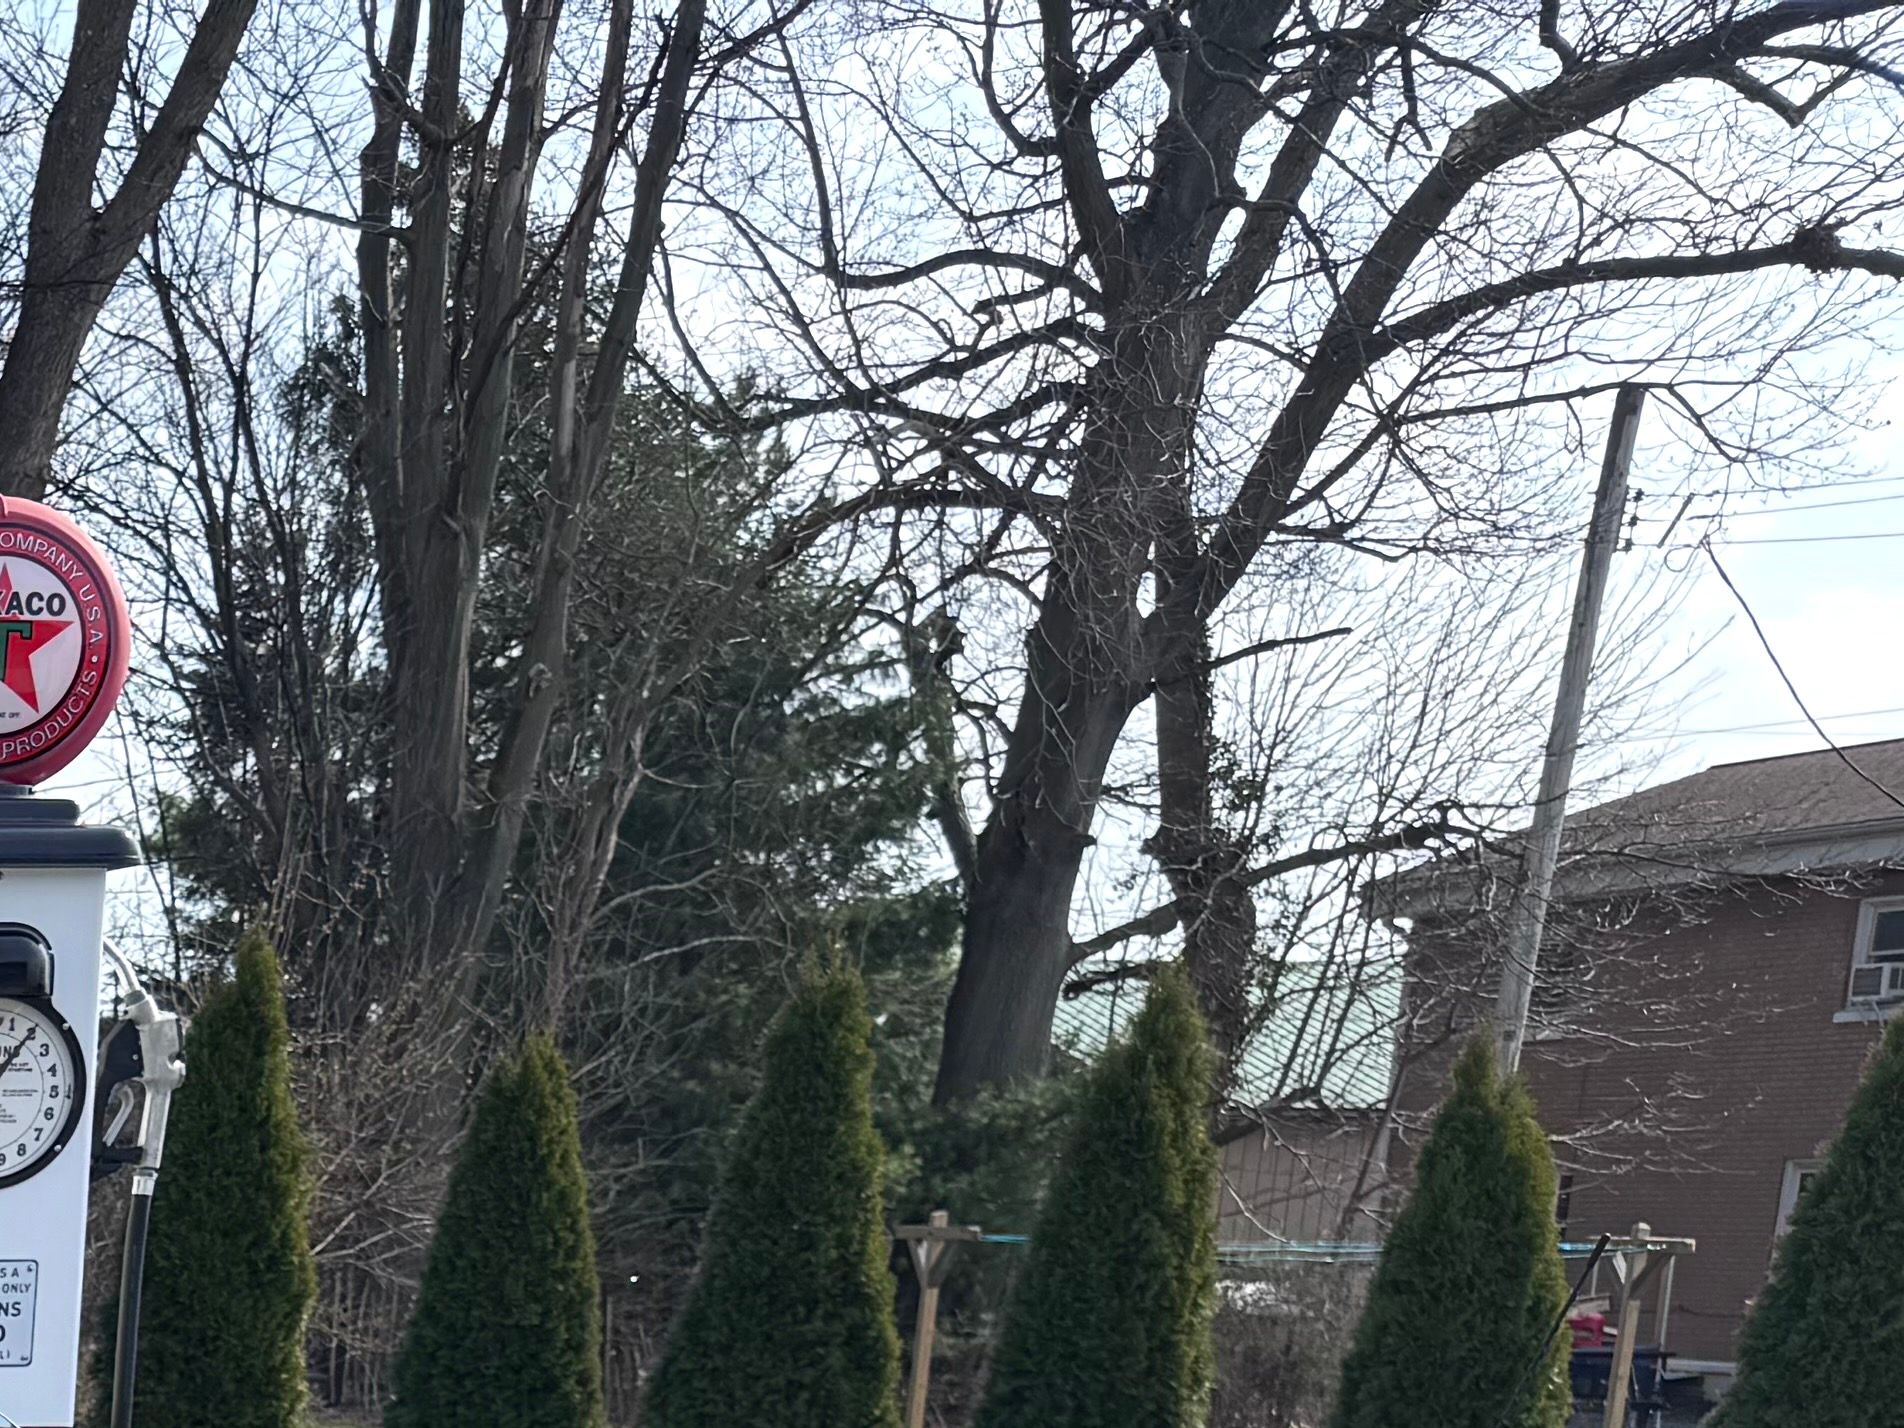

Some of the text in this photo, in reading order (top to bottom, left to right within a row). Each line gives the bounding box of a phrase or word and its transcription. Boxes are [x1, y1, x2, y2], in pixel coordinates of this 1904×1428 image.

[2, 669, 98, 760] PRODUCTS
[9, 1019, 15, 1031] 1
[40, 1044, 49, 1057] 3
[47, 1065, 57, 1076] 4
[49, 1086, 58, 1097] 5
[45, 1108, 53, 1120] 6
[34, 1128, 43, 1141] 7
[17, 1144, 26, 1156] 8
[11, 1268, 19, 1277] A
[2, 1284, 31, 1293] ONLY
